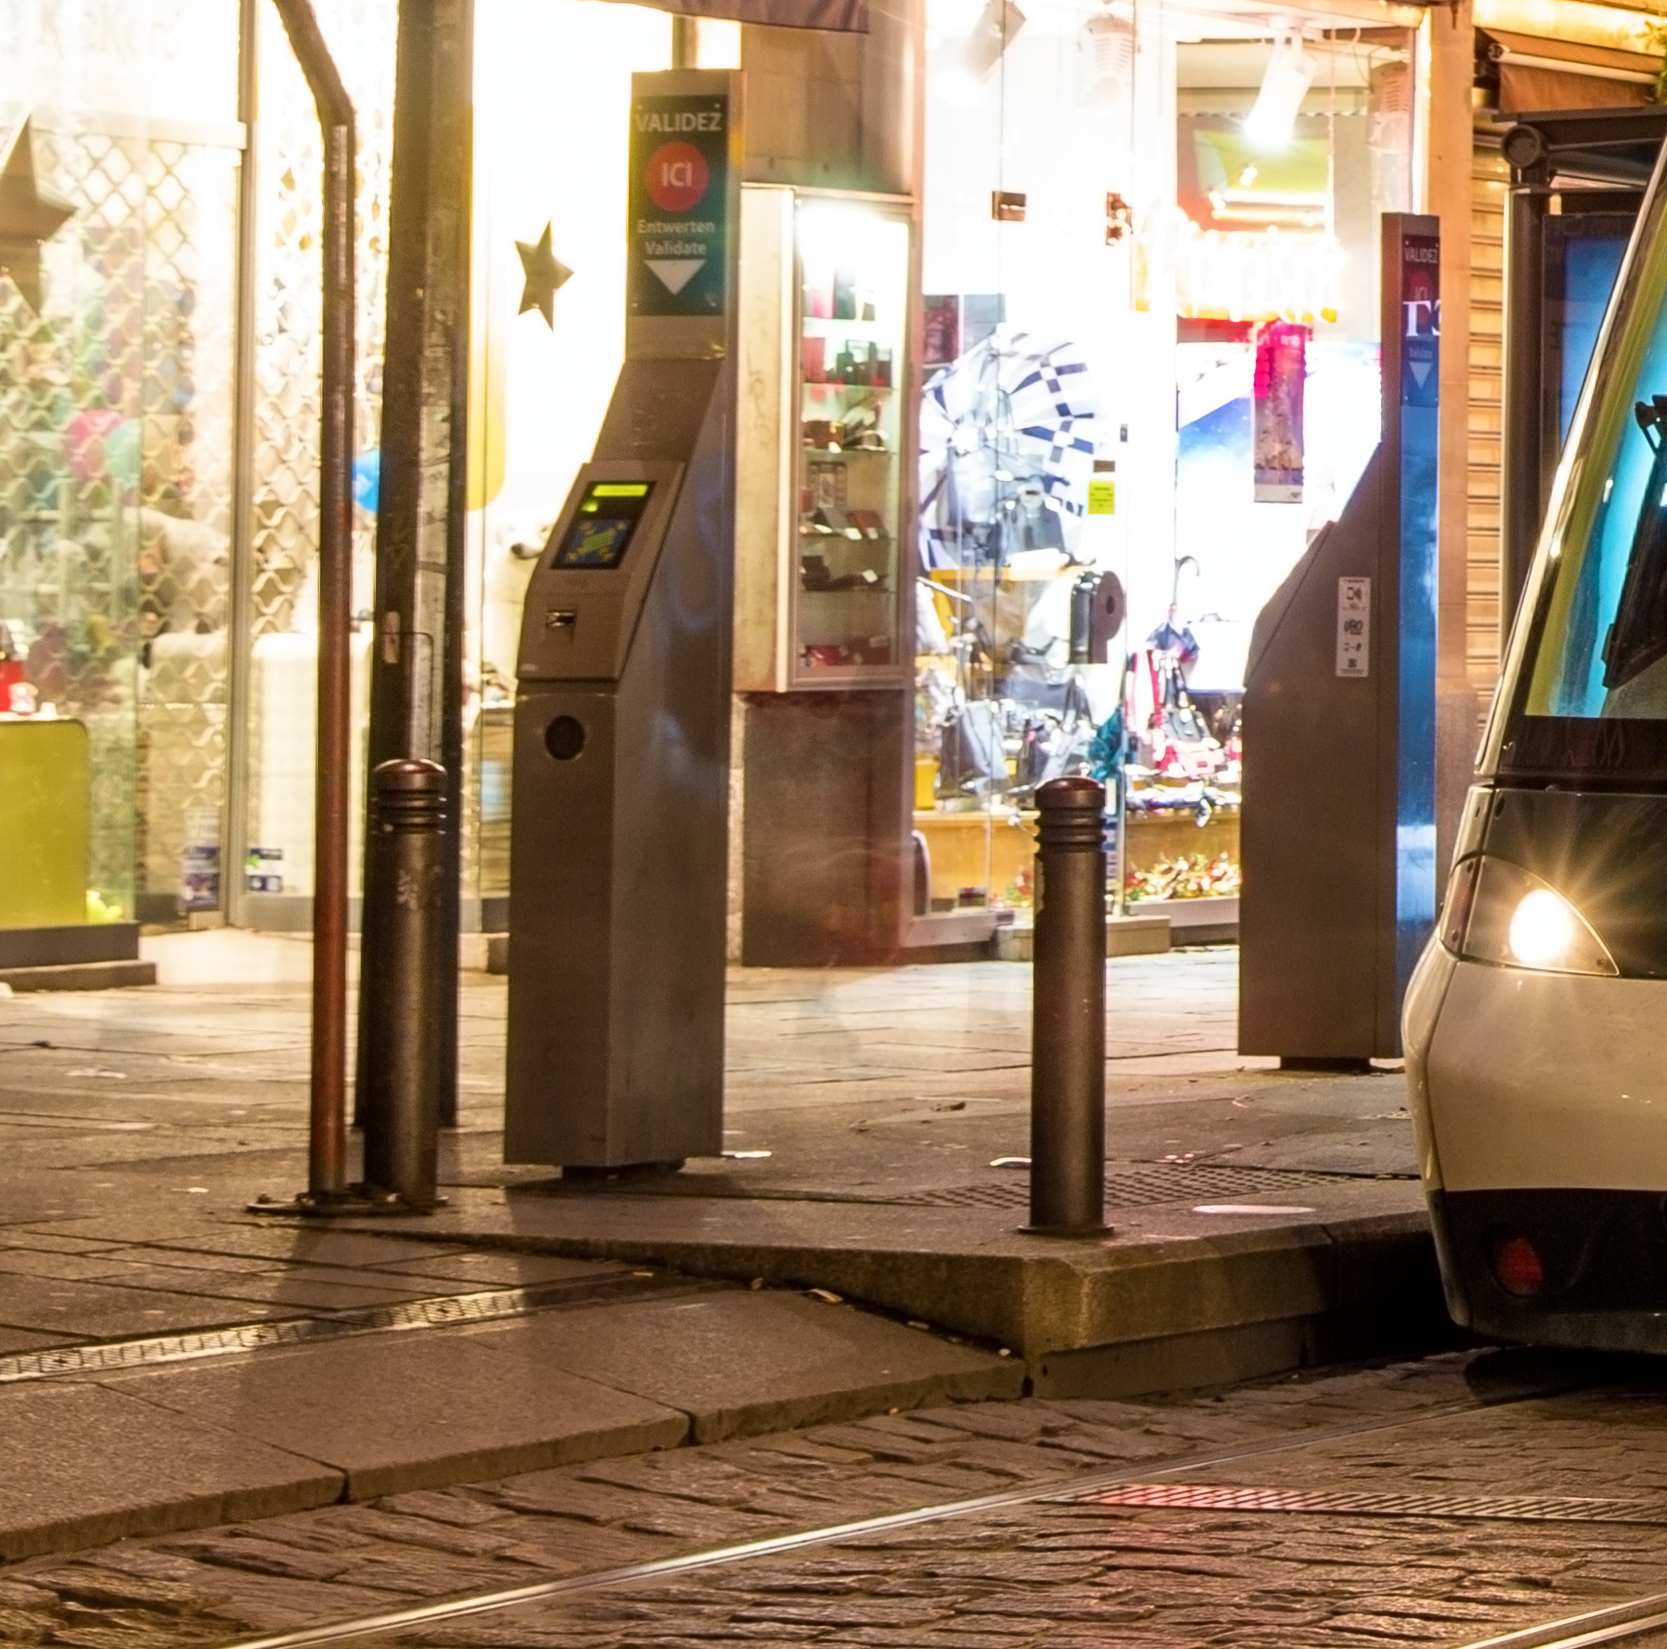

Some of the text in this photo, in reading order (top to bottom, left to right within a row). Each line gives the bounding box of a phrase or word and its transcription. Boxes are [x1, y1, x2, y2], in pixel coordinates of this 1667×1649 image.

[634, 111, 723, 133] VALIDEZ
[660, 162, 694, 188] ICI
[636, 219, 716, 235] Entwerten
[644, 240, 708, 256] Validate
[1404, 247, 1438, 264] VALIDEZ
